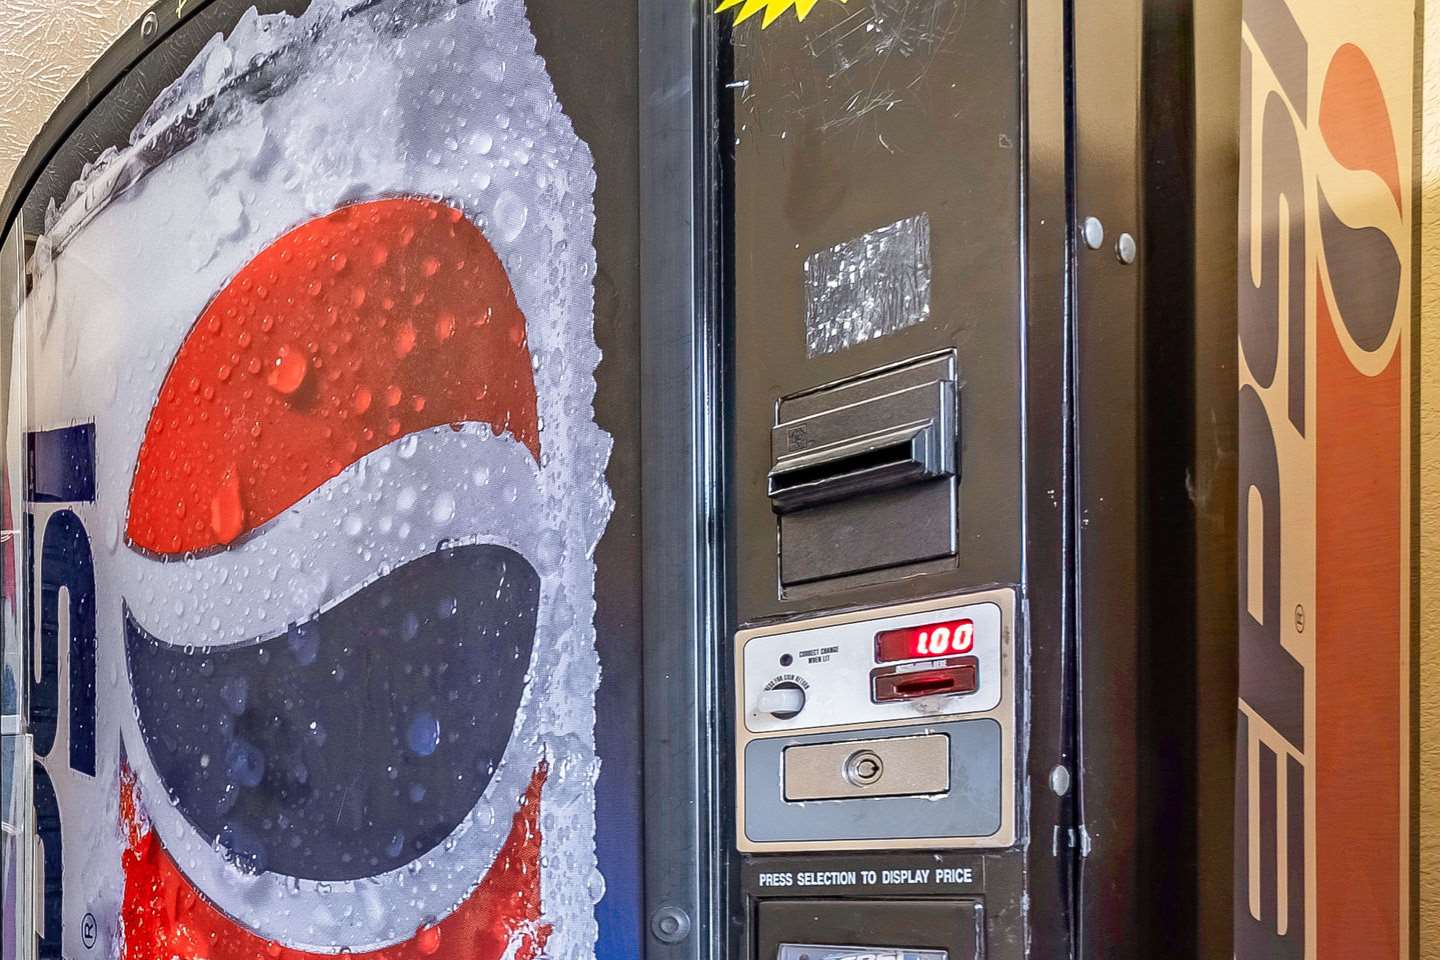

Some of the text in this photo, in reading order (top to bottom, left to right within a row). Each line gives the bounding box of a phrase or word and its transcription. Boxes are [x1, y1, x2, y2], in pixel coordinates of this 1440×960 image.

[759, 868, 973, 887] PRESS SELECTION TO DISPLAY PRICE
